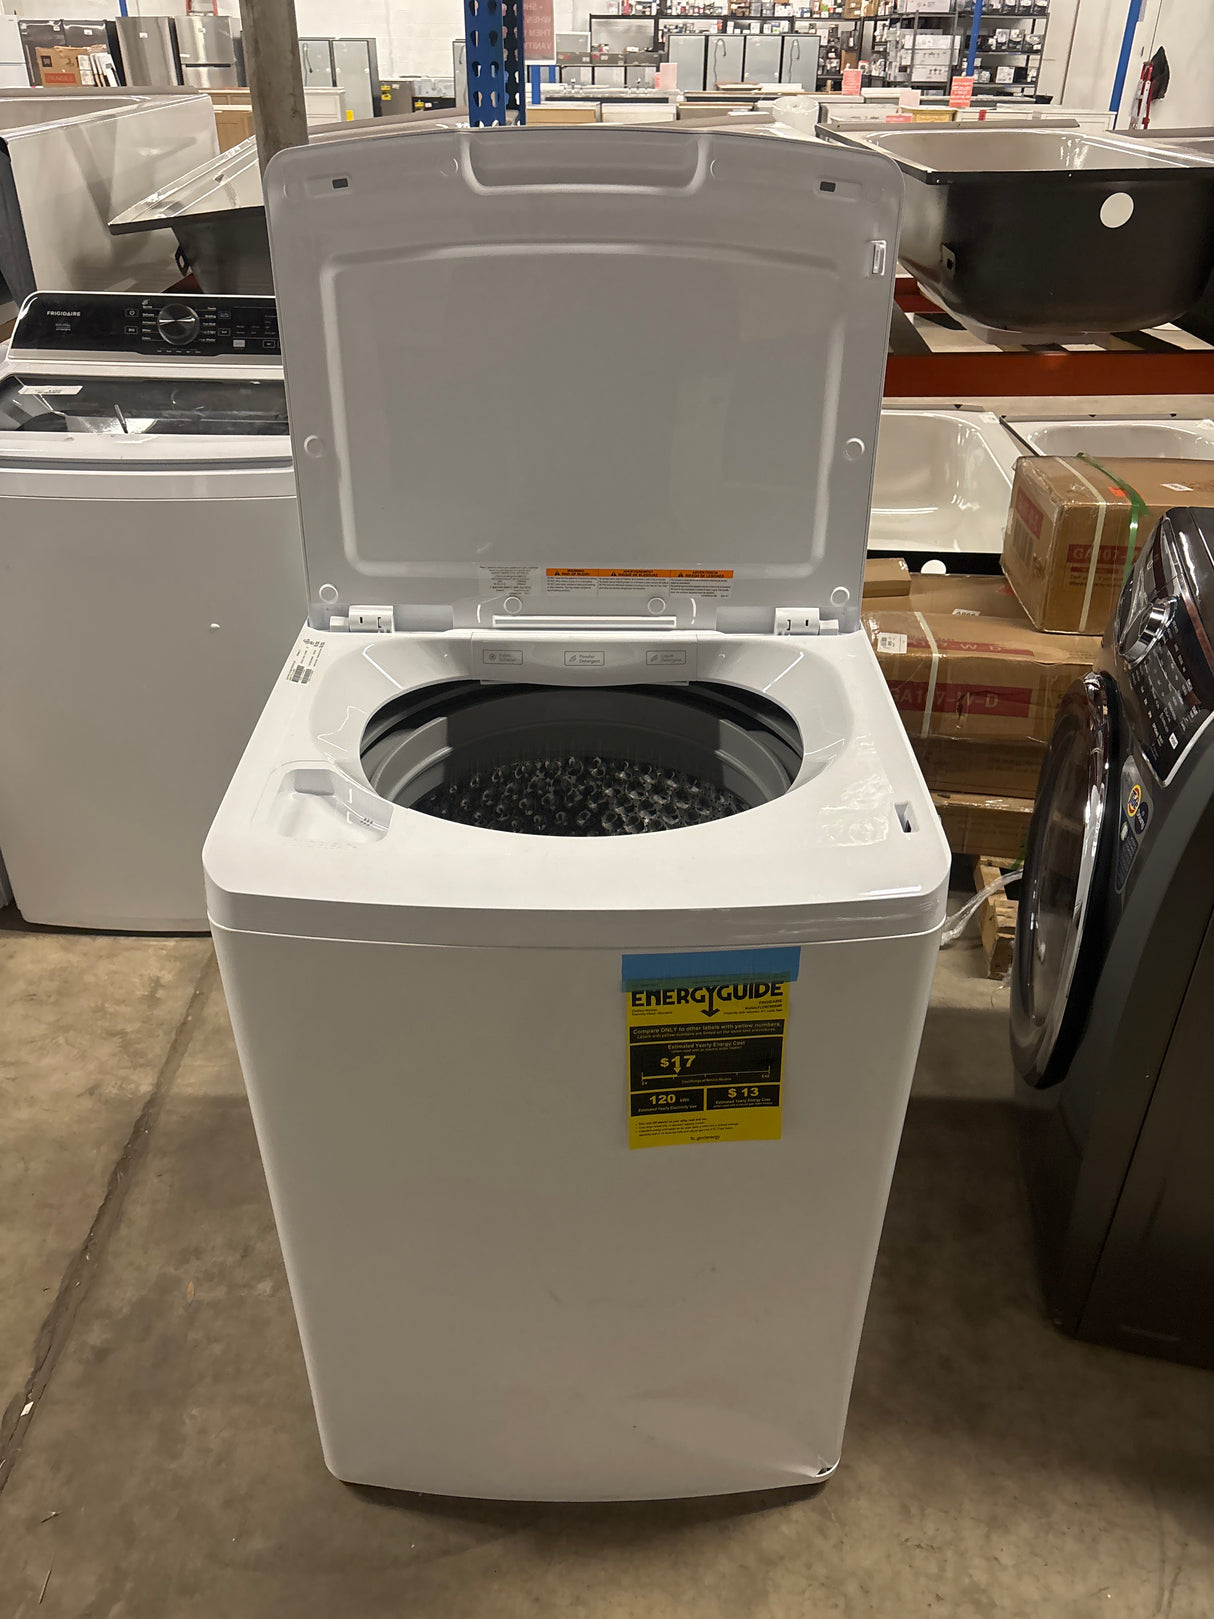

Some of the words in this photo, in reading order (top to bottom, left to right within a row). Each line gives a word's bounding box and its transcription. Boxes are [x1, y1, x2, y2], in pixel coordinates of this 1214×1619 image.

[632, 982, 784, 1008] ENERGYGUIDE
[695, 1041, 712, 1049] Yearly
[660, 1055, 696, 1069] $17
[727, 1088, 737, 1098] $
[741, 1087, 759, 1097] 13
[649, 1094, 676, 1105] 120
